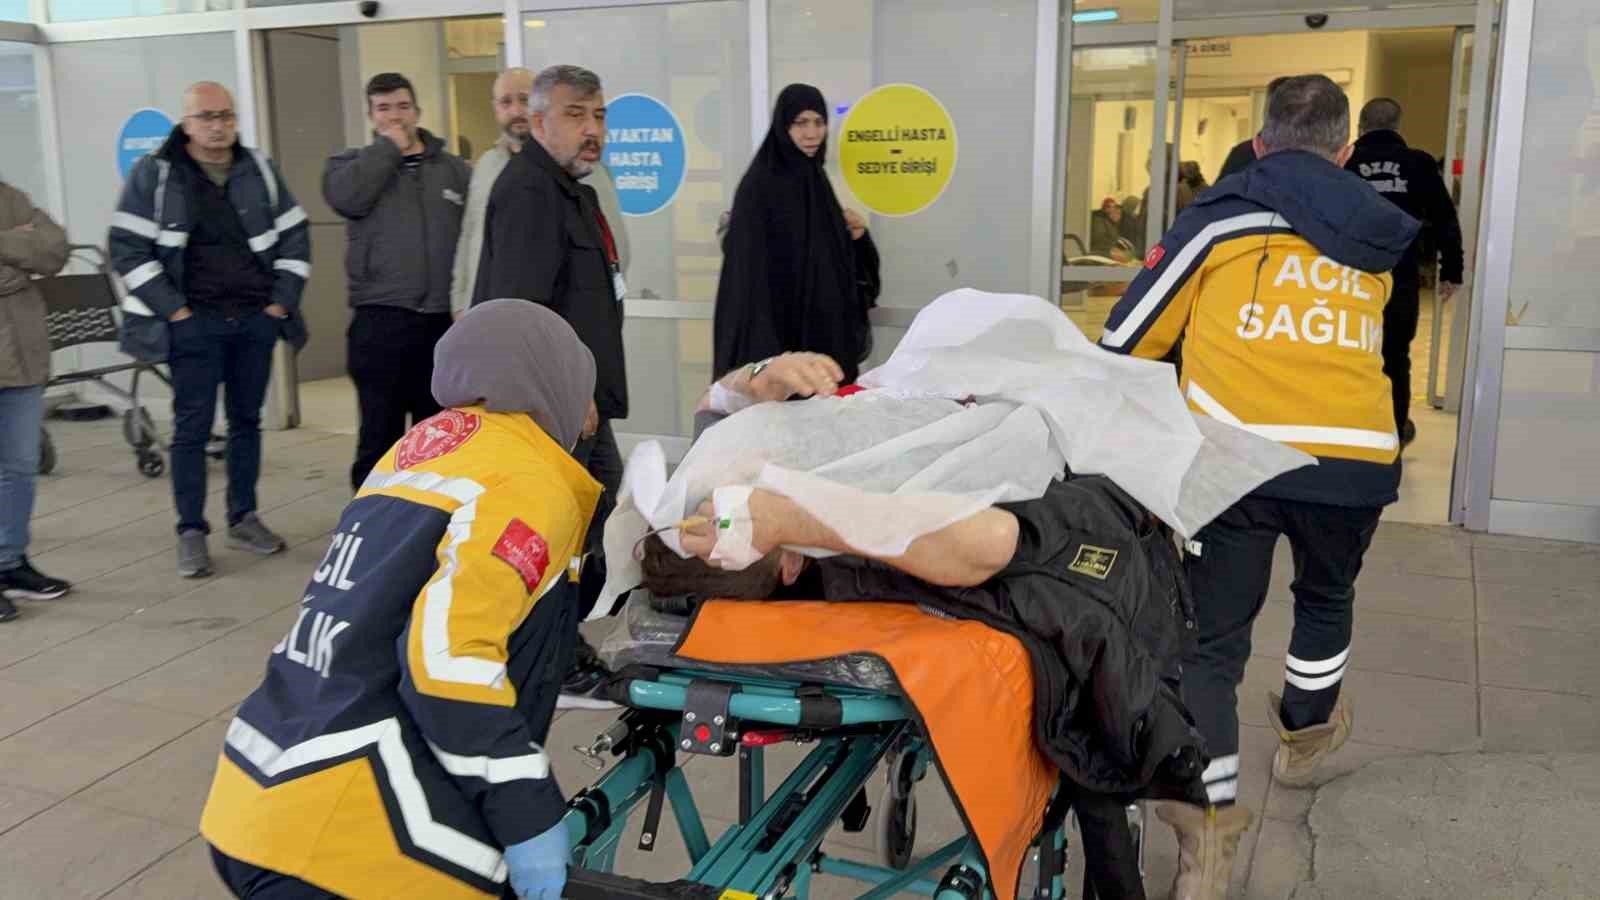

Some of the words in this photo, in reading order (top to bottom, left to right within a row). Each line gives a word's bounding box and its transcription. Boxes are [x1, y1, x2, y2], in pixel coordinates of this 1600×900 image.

[847, 125, 898, 142] ENGELLİ
[902, 128, 946, 141] HASTA
[609, 152, 663, 167] HASTA
[857, 161, 897, 174] SEDYE
[901, 157, 936, 175] GİRİŞİ
[313, 522, 364, 590] CİL
